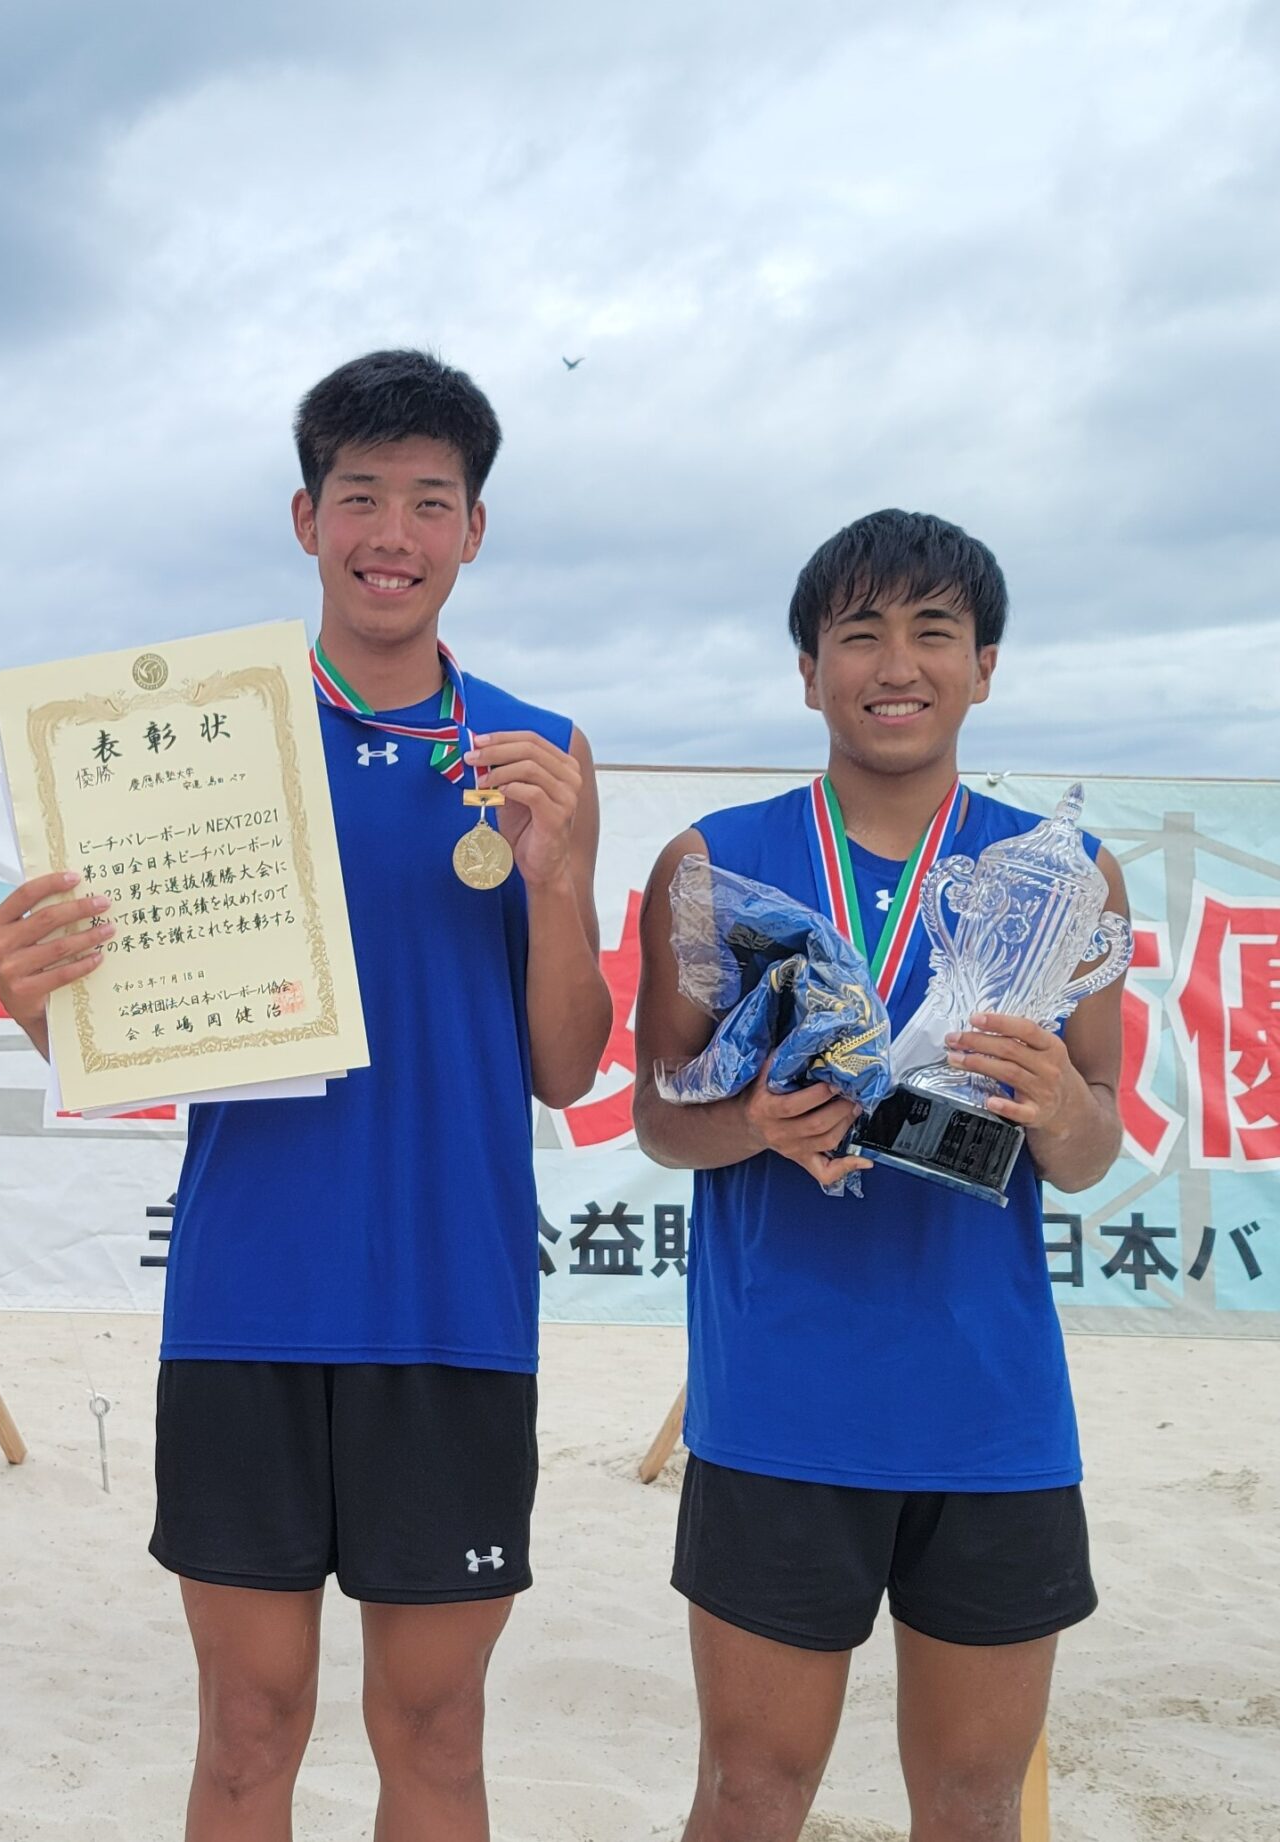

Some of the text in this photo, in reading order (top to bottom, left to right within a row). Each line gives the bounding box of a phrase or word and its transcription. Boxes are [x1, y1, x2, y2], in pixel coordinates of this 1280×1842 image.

[92, 712, 231, 764] 表彰状
[75, 764, 115, 789] 優勝
[206, 808, 279, 835] NEXT2021
